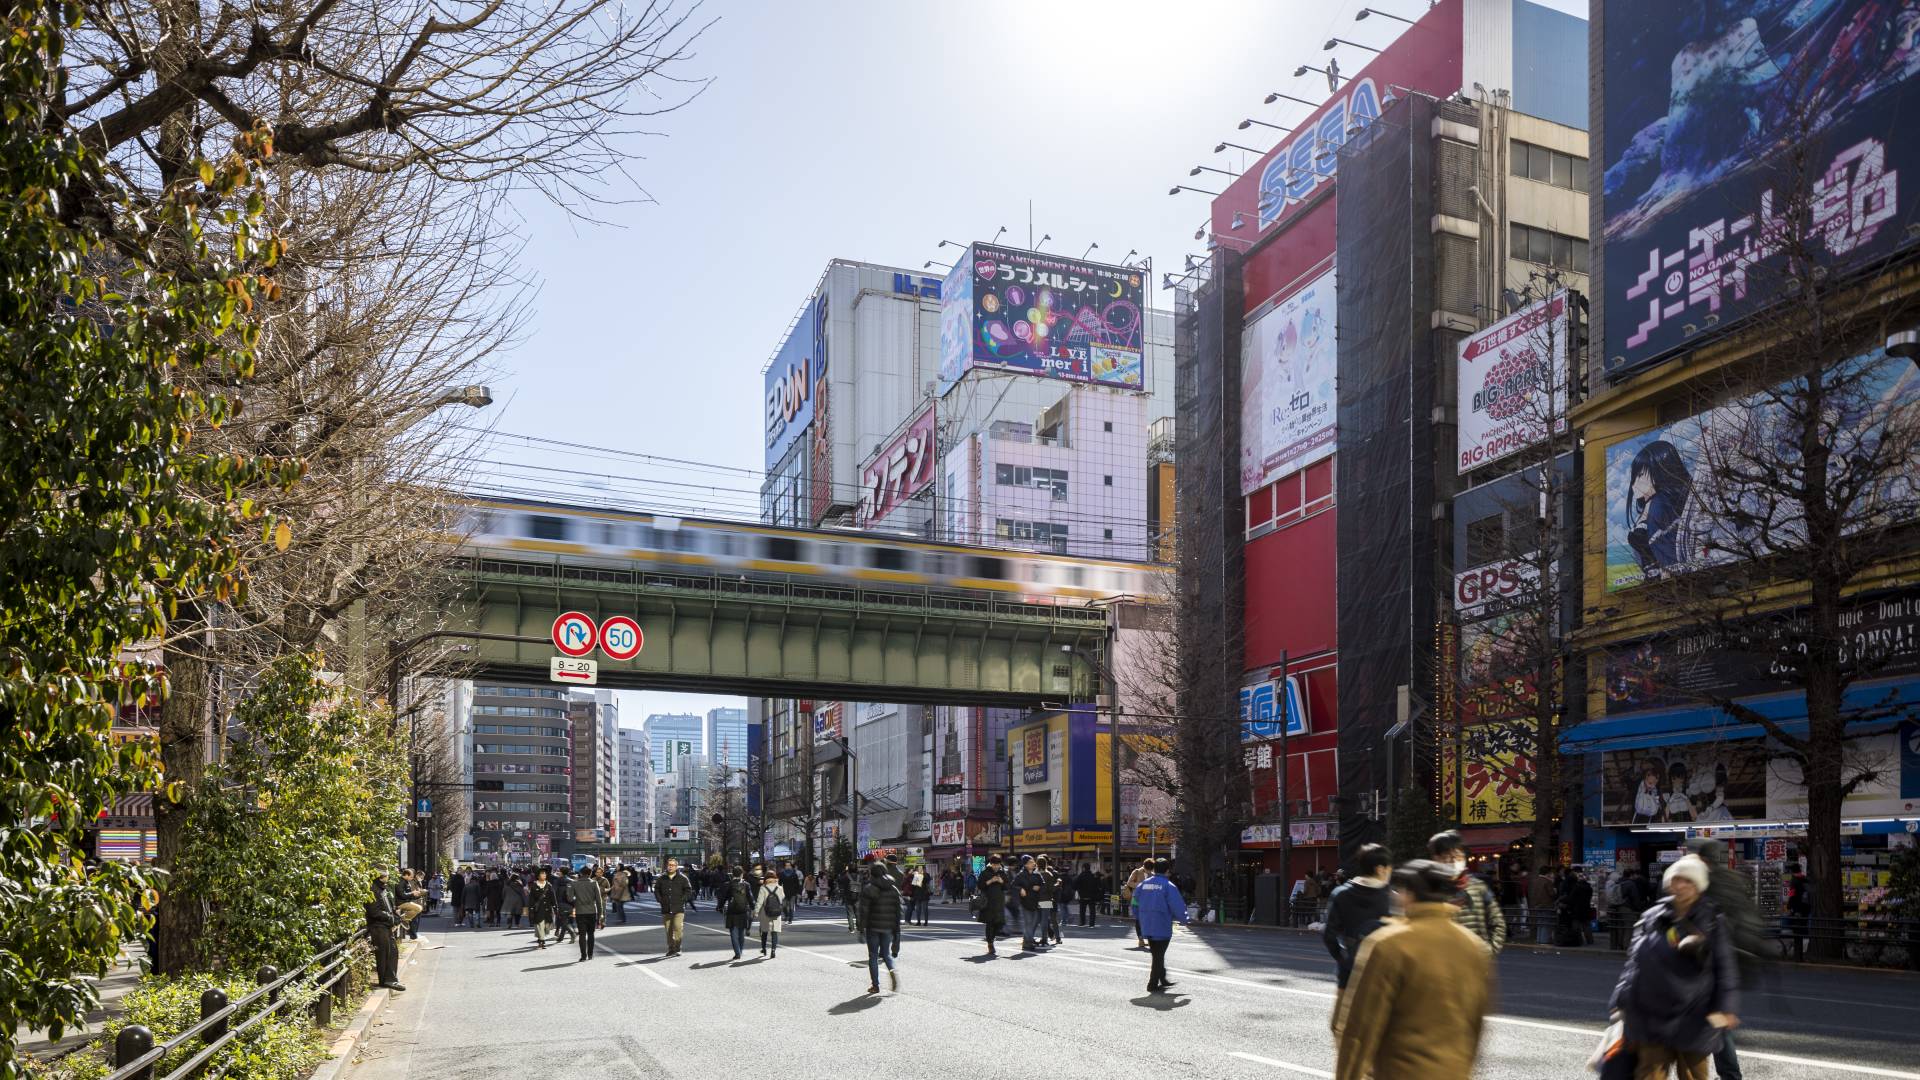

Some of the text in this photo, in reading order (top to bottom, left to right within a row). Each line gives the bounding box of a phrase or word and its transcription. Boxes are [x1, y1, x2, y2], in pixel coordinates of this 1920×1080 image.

[1258, 77, 1387, 233] SEGA
[997, 263, 1099, 292] ラブメルシー
[1009, 255, 1067, 270] AMUSEMENT
[1069, 265, 1094, 276] PARK
[1690, 265, 1705, 280] NO
[1708, 246, 1741, 271] GAME
[1472, 385, 1498, 413] BIG
[1461, 445, 1484, 468] BIG
[1486, 427, 1525, 457] APPLE
[1458, 562, 1521, 604] GPS
[609, 628, 633, 648] 50
[558, 661, 565, 669] 8
[577, 662, 590, 671] 20
[1240, 676, 1308, 742] EGA
[1244, 744, 1273, 770] 号館
